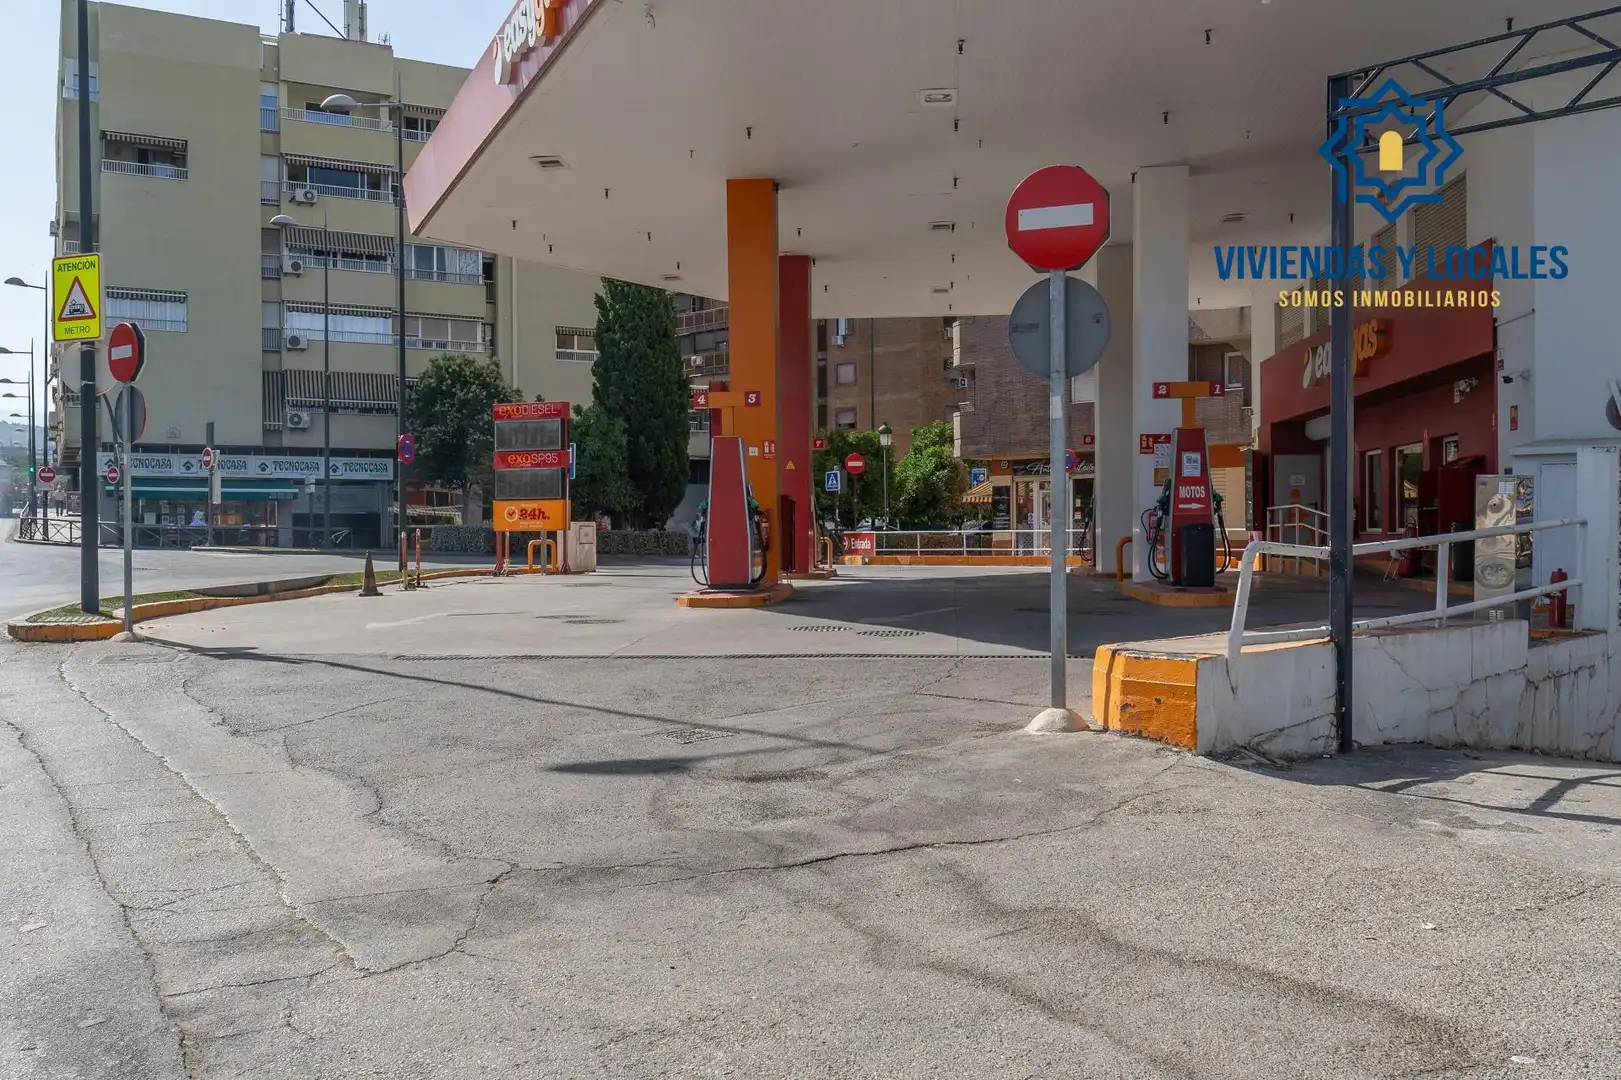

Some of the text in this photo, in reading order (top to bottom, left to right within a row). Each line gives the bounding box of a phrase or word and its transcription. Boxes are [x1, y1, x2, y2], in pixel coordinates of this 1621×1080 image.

[57, 259, 96, 272] ATENCIÓN
[64, 326, 91, 335] METRO
[1159, 385, 1167, 394] 2
[1214, 384, 1221, 394] 1
[697, 394, 706, 404] 4
[748, 393, 757, 403] 3
[272, 460, 320, 472] TECNOCASA
[342, 462, 389, 473] TECNOCASA
[1179, 485, 1206, 498] MOTOS
[851, 537, 872, 550] Entrada
